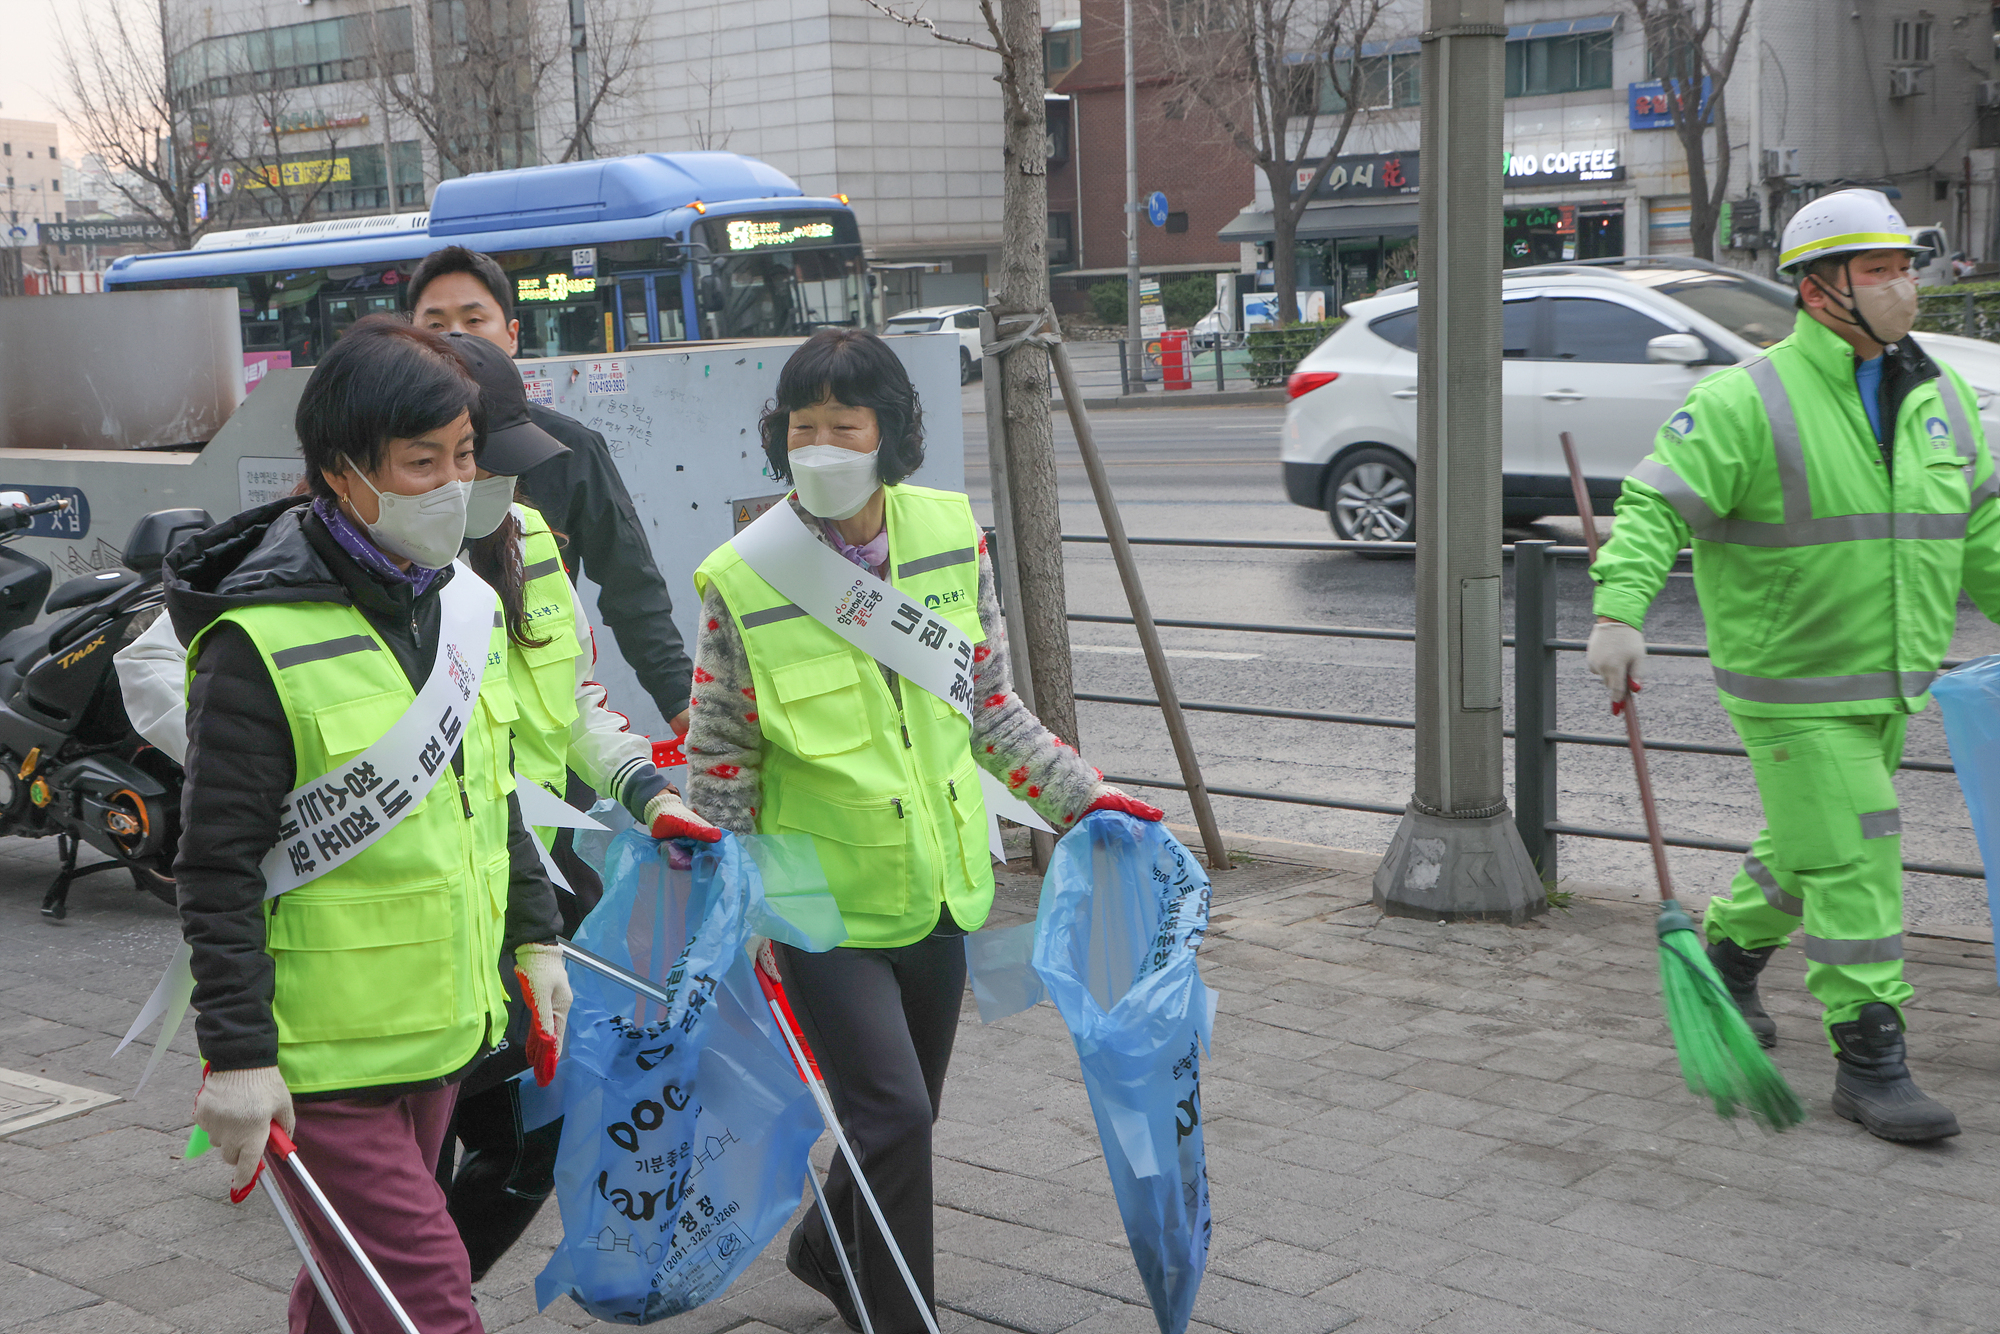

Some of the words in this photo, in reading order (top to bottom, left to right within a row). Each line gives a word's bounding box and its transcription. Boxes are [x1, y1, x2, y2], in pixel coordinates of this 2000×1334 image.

[1542, 149, 1616, 174] COFFEE
[1526, 208, 1558, 225] Cafe
[574, 250, 591, 264] 150
[281, 472, 294, 484] 우리
[835, 579, 864, 615] dobong
[942, 588, 966, 604] 도봉구
[532, 604, 560, 617] 도봉구
[487, 650, 503, 667] 도봉
